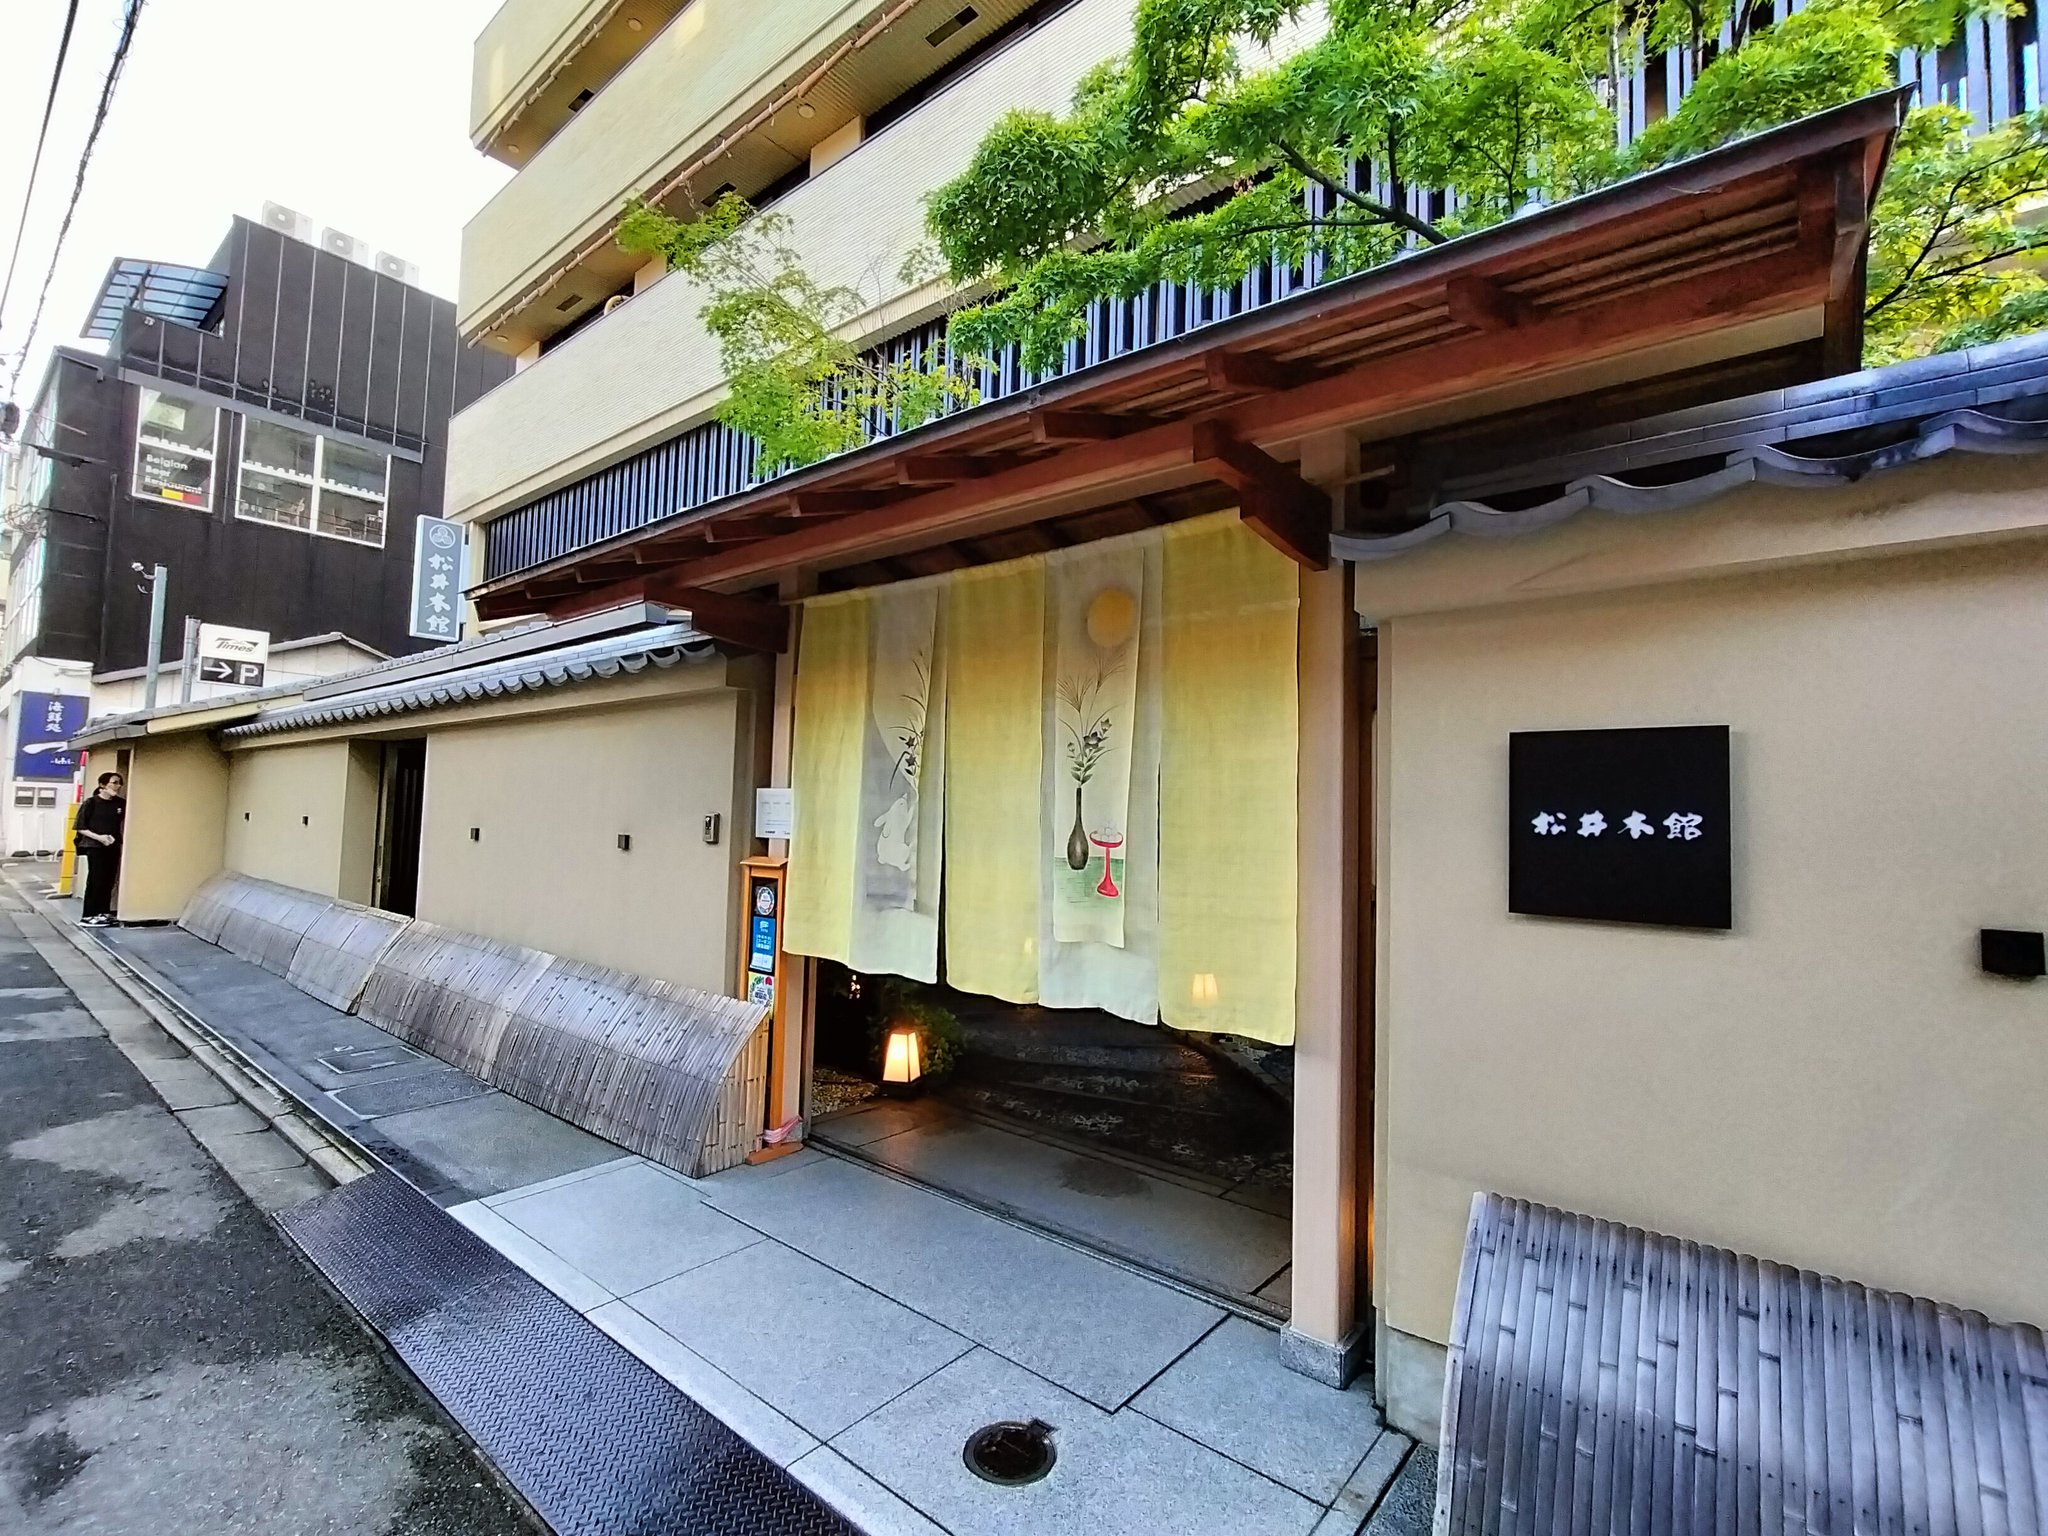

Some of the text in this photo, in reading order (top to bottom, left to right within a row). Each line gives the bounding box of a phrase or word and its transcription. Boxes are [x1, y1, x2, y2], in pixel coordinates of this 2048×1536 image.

[145, 465, 171, 477] Beer
[146, 453, 188, 471] Belgian
[144, 475, 203, 495] Restaurant
[425, 552, 454, 634] 松井本館
[215, 637, 258, 653] Times
[239, 663, 259, 685] P
[1530, 809, 1704, 841] 松井本館
